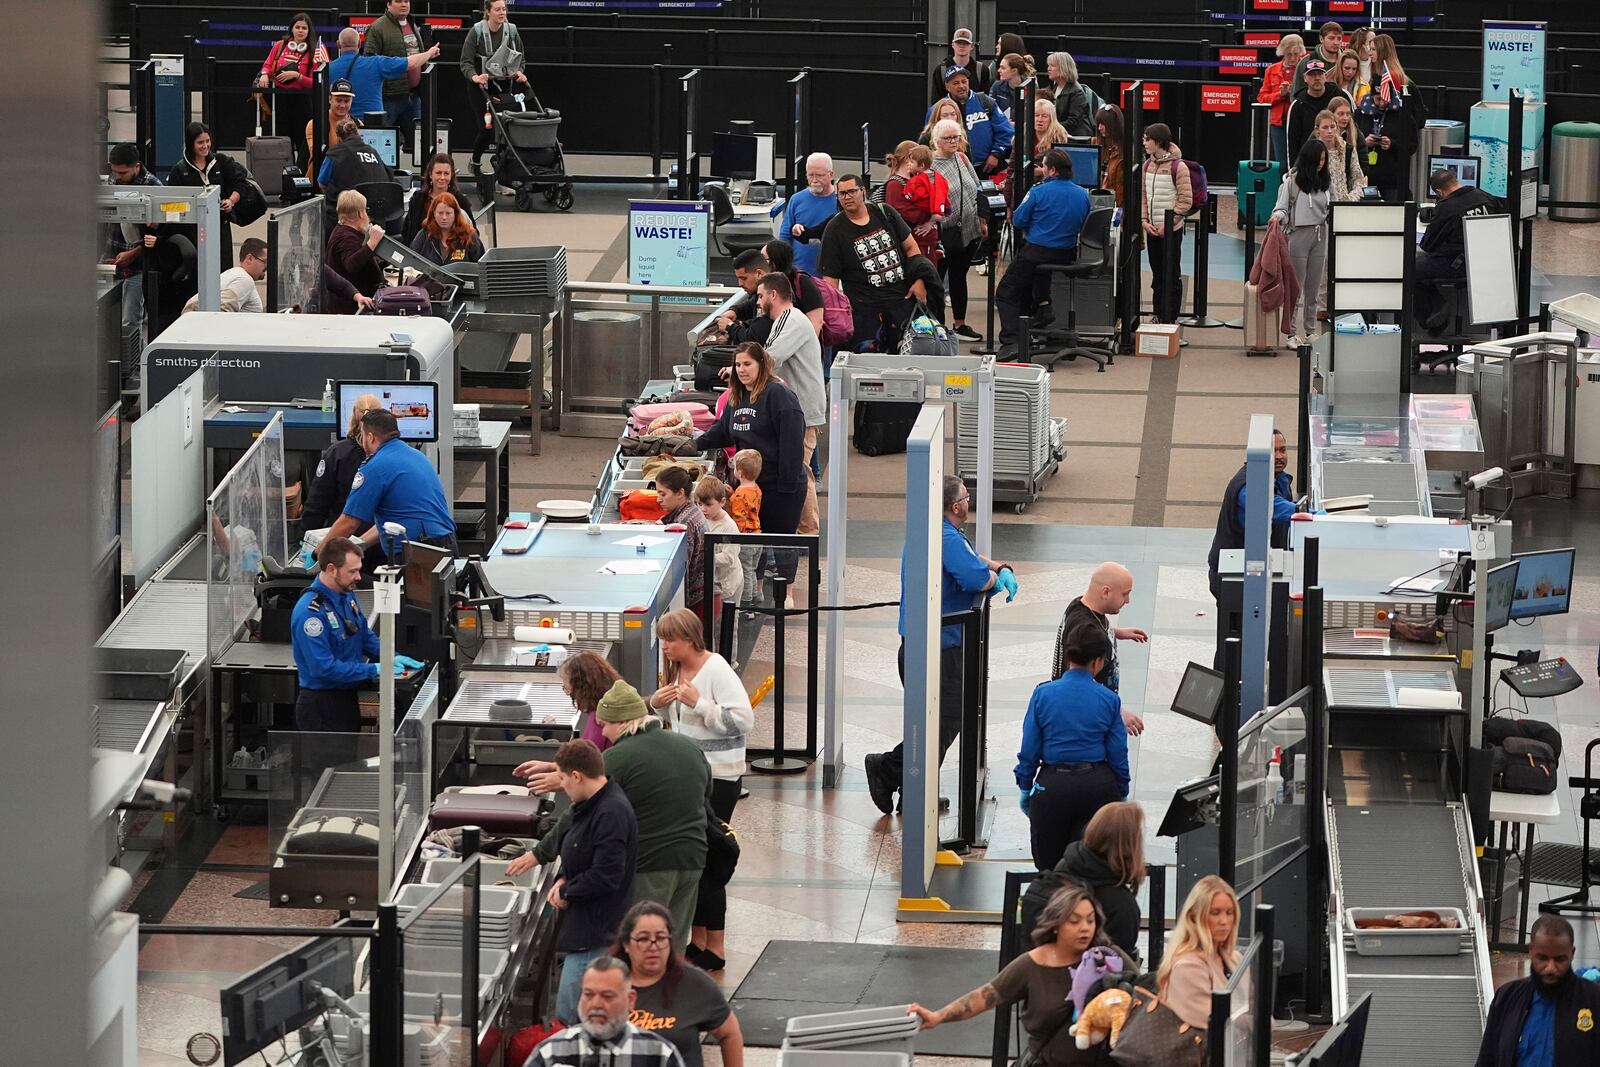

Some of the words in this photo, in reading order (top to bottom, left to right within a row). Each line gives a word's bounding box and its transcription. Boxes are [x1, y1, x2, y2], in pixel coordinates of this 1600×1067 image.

[1488, 31, 1537, 42] REDUCE
[1488, 41, 1533, 52] WASTE!
[356, 151, 379, 164] TSA
[635, 214, 697, 227] REDUCE
[635, 226, 692, 239] WASTE!
[638, 255, 657, 263] Dump
[638, 263, 655, 271] liquid
[155, 357, 198, 366] smiths
[733, 407, 757, 418] FAVORITE
[732, 422, 751, 431] SISTER
[1476, 533, 1487, 551] 8
[379, 588, 393, 606] 7
[628, 1009, 676, 1030] Believe
